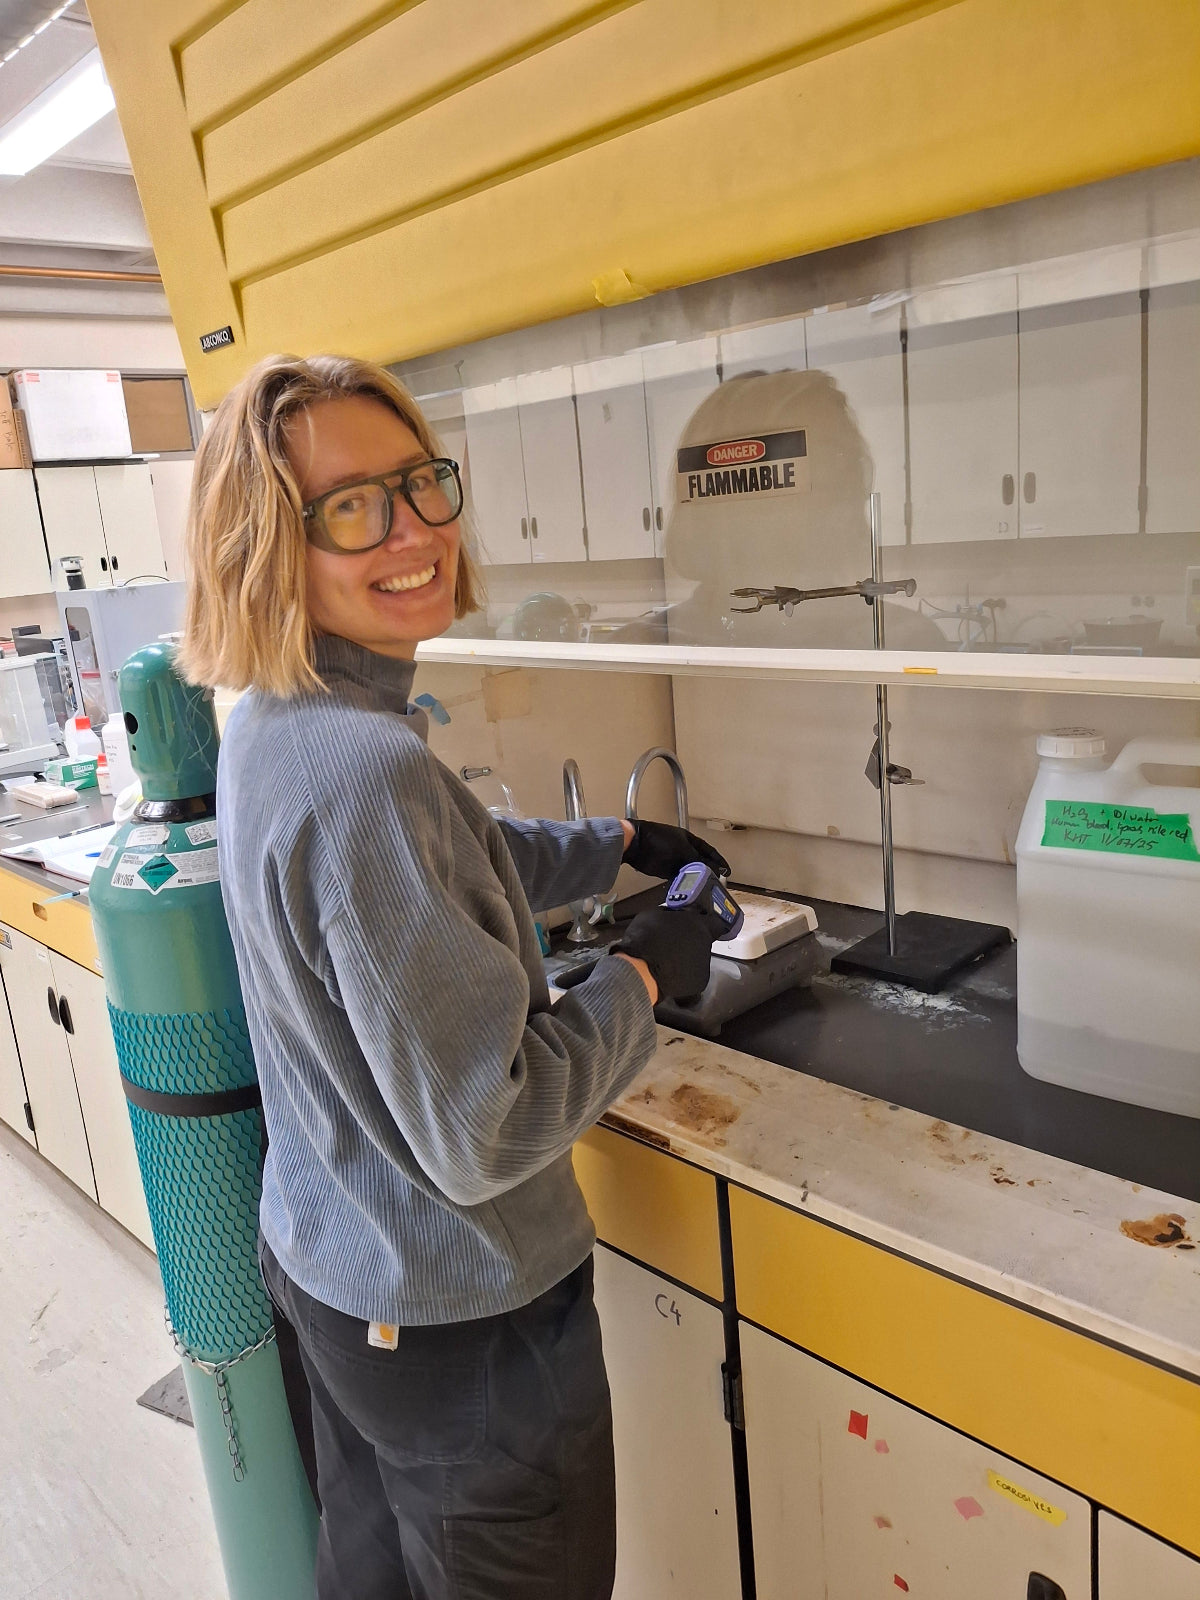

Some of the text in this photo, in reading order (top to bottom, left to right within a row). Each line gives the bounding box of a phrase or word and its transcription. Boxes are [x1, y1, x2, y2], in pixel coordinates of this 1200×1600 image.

[713, 444, 758, 462] DANGER
[688, 462, 795, 499] FLAMMABLE
[1169, 828, 1189, 844] red
[655, 1293, 682, 1326] C4
